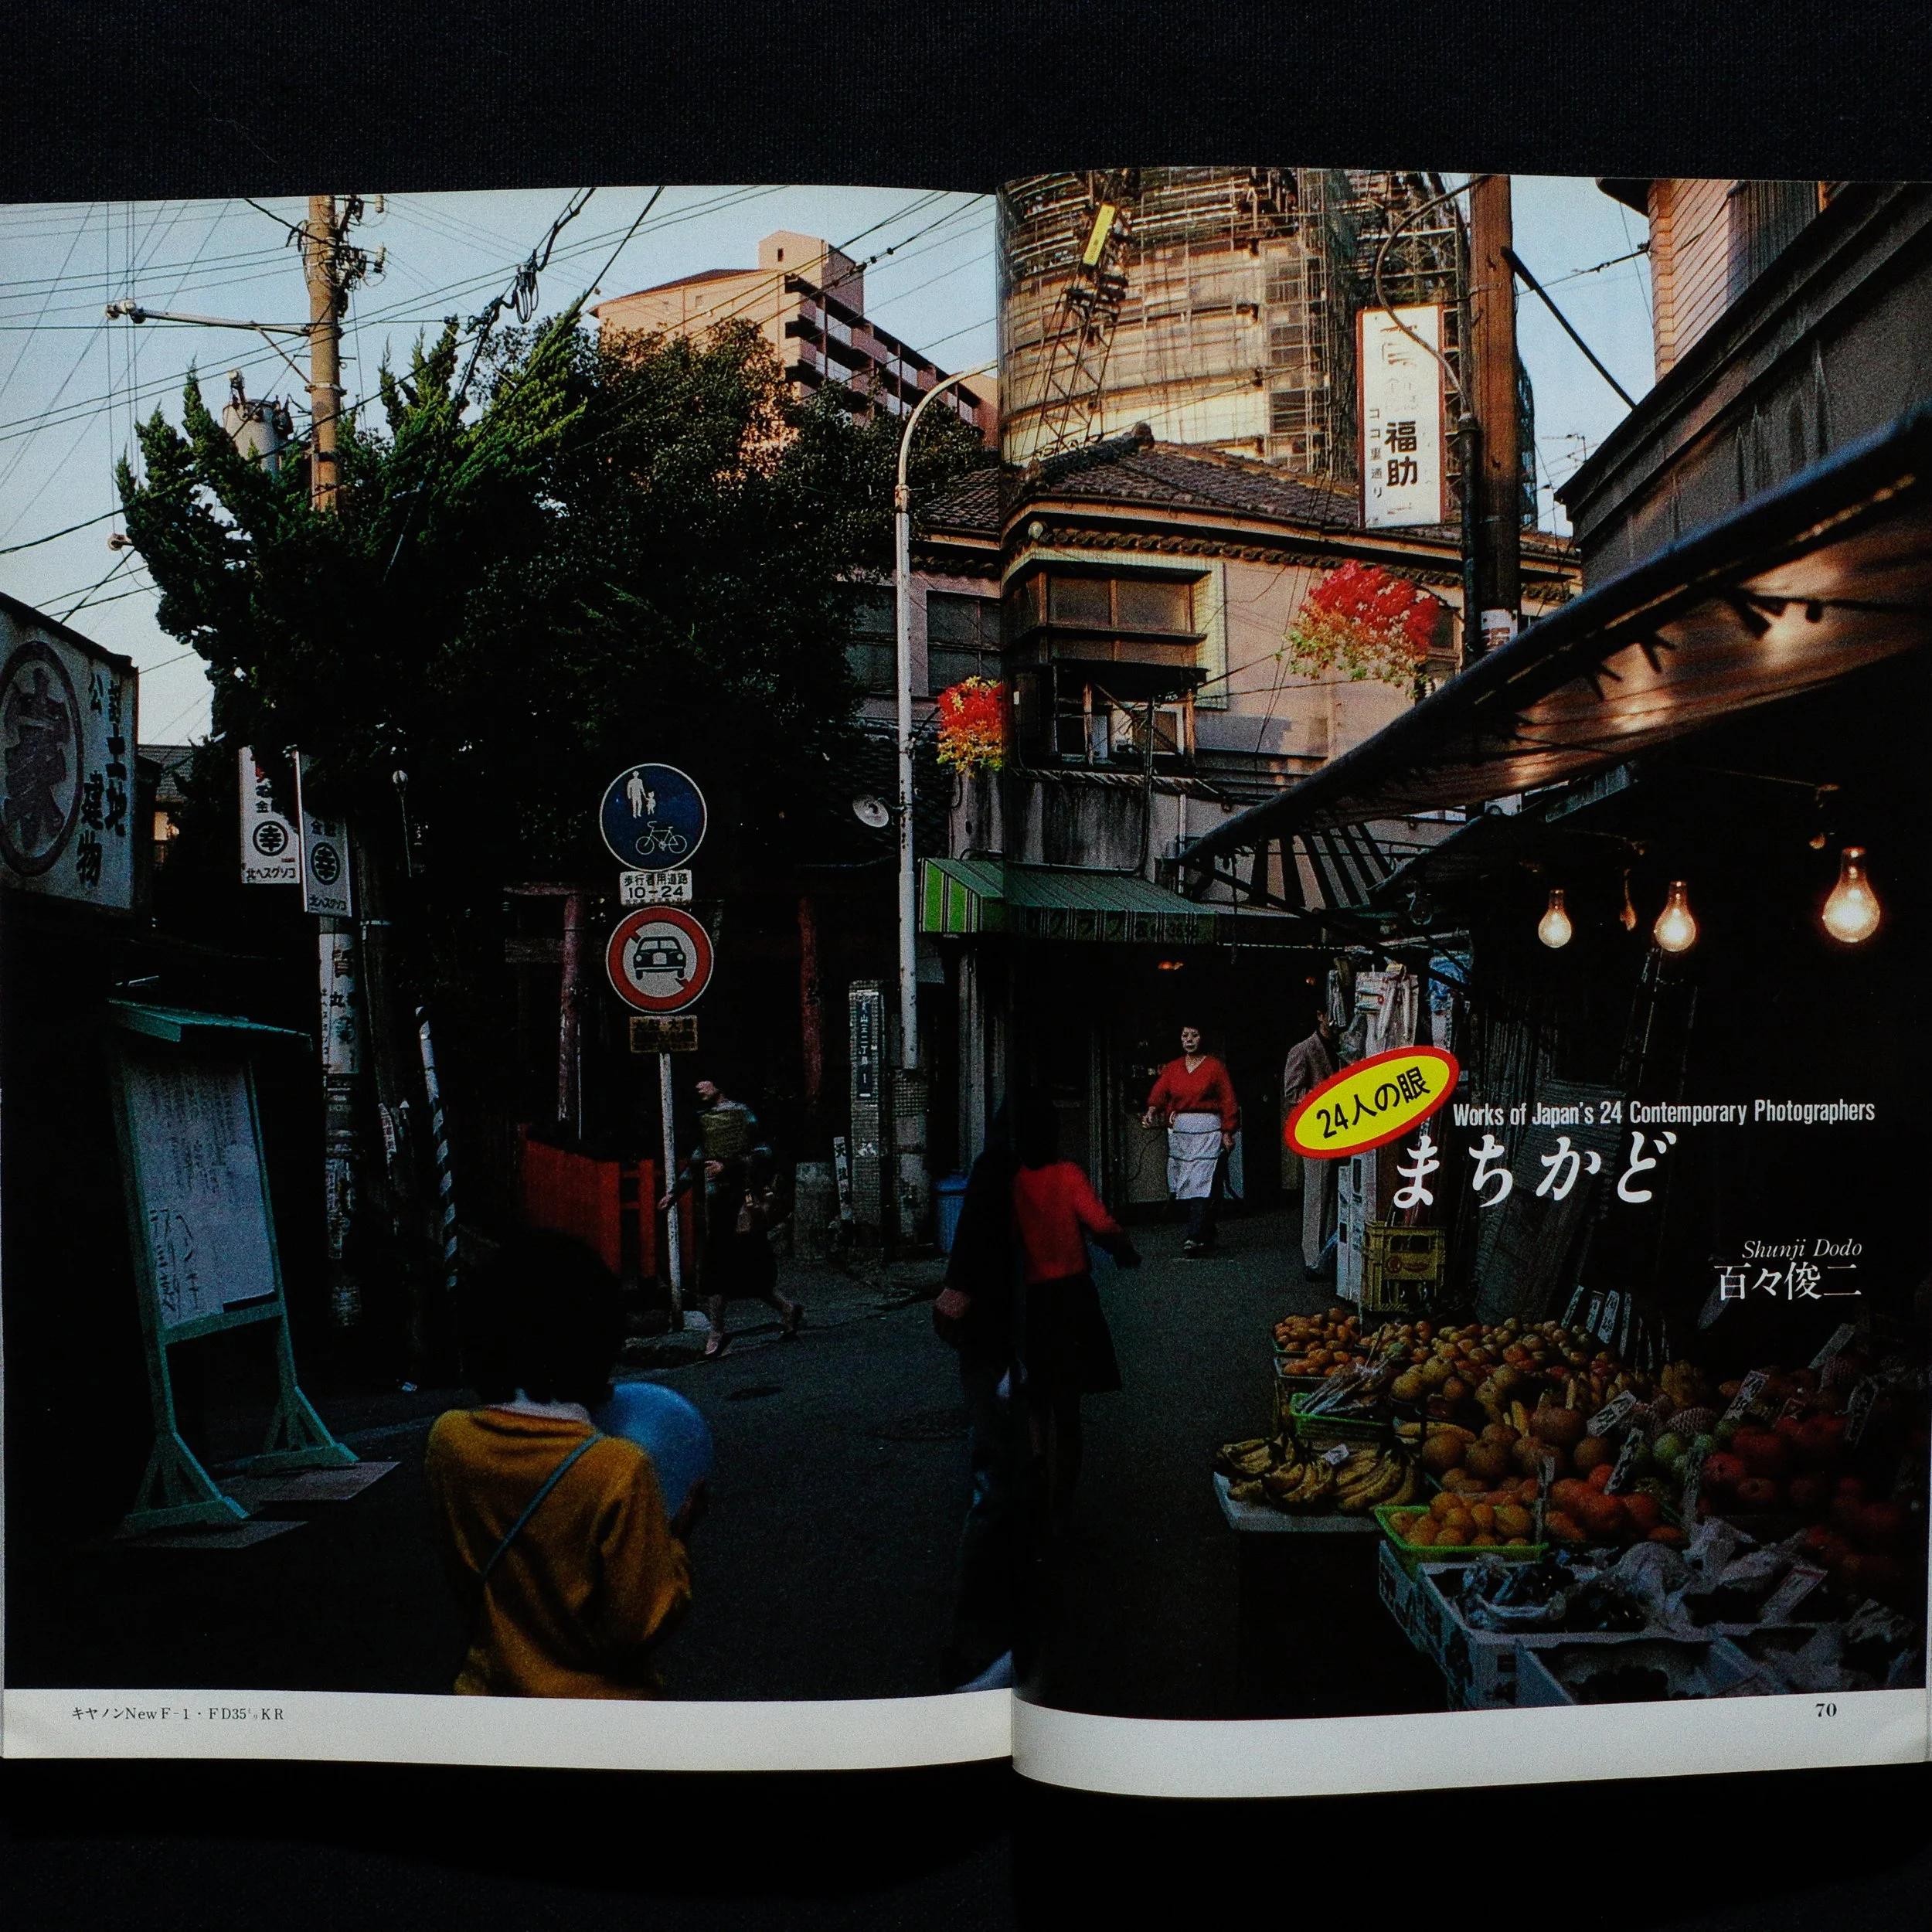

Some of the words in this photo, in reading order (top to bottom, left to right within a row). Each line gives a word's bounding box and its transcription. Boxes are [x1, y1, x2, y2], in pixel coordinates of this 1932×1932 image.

[1385, 420, 1418, 487] 福助
[256, 823, 285, 853] 幸
[624, 873, 688, 886] 歩行者用道路
[629, 886, 684, 899] 10-24
